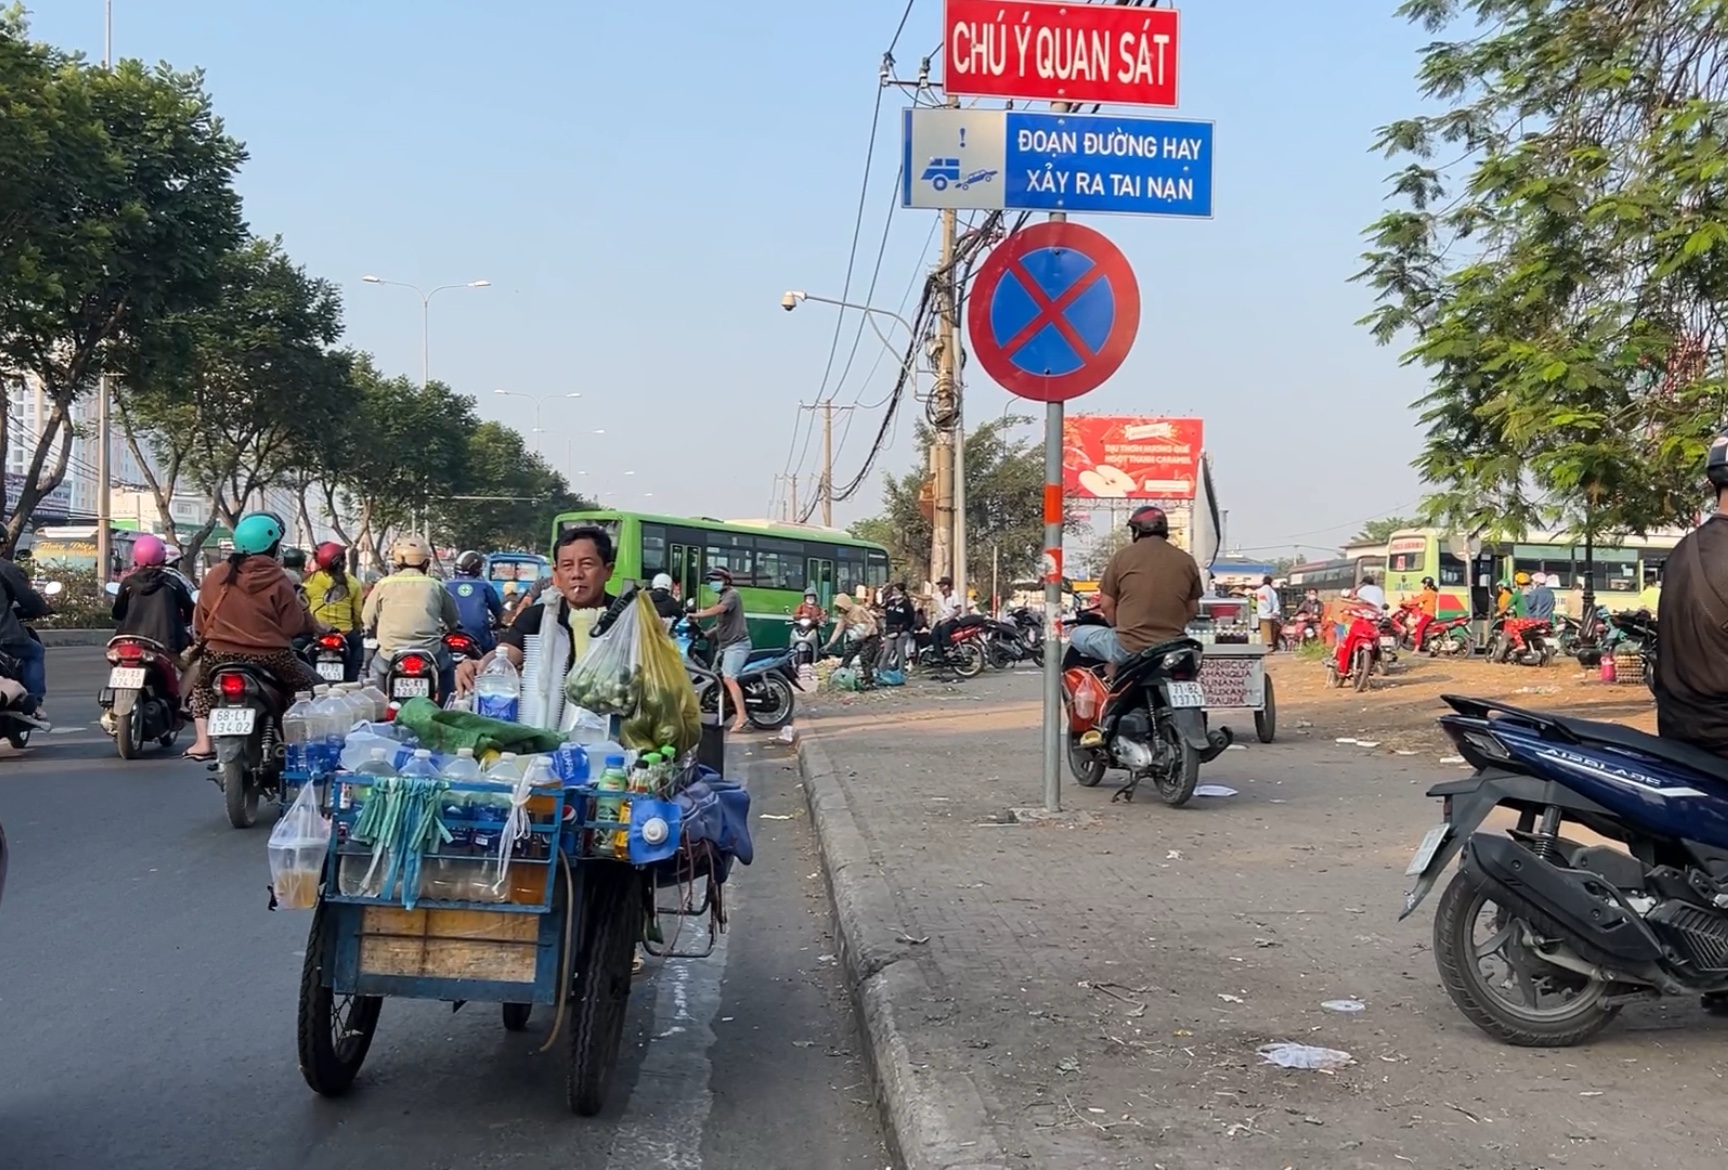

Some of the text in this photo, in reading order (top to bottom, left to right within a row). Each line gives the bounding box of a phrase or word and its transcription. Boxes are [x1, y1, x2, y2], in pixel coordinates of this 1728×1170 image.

[952, 10, 1170, 86] CHÚ Ý QUAN SÁT
[1018, 127, 1203, 161] ĐOẠN ĐƯỜNG HAY
[1026, 162, 1193, 203] XẢY RA TAI NẠN
